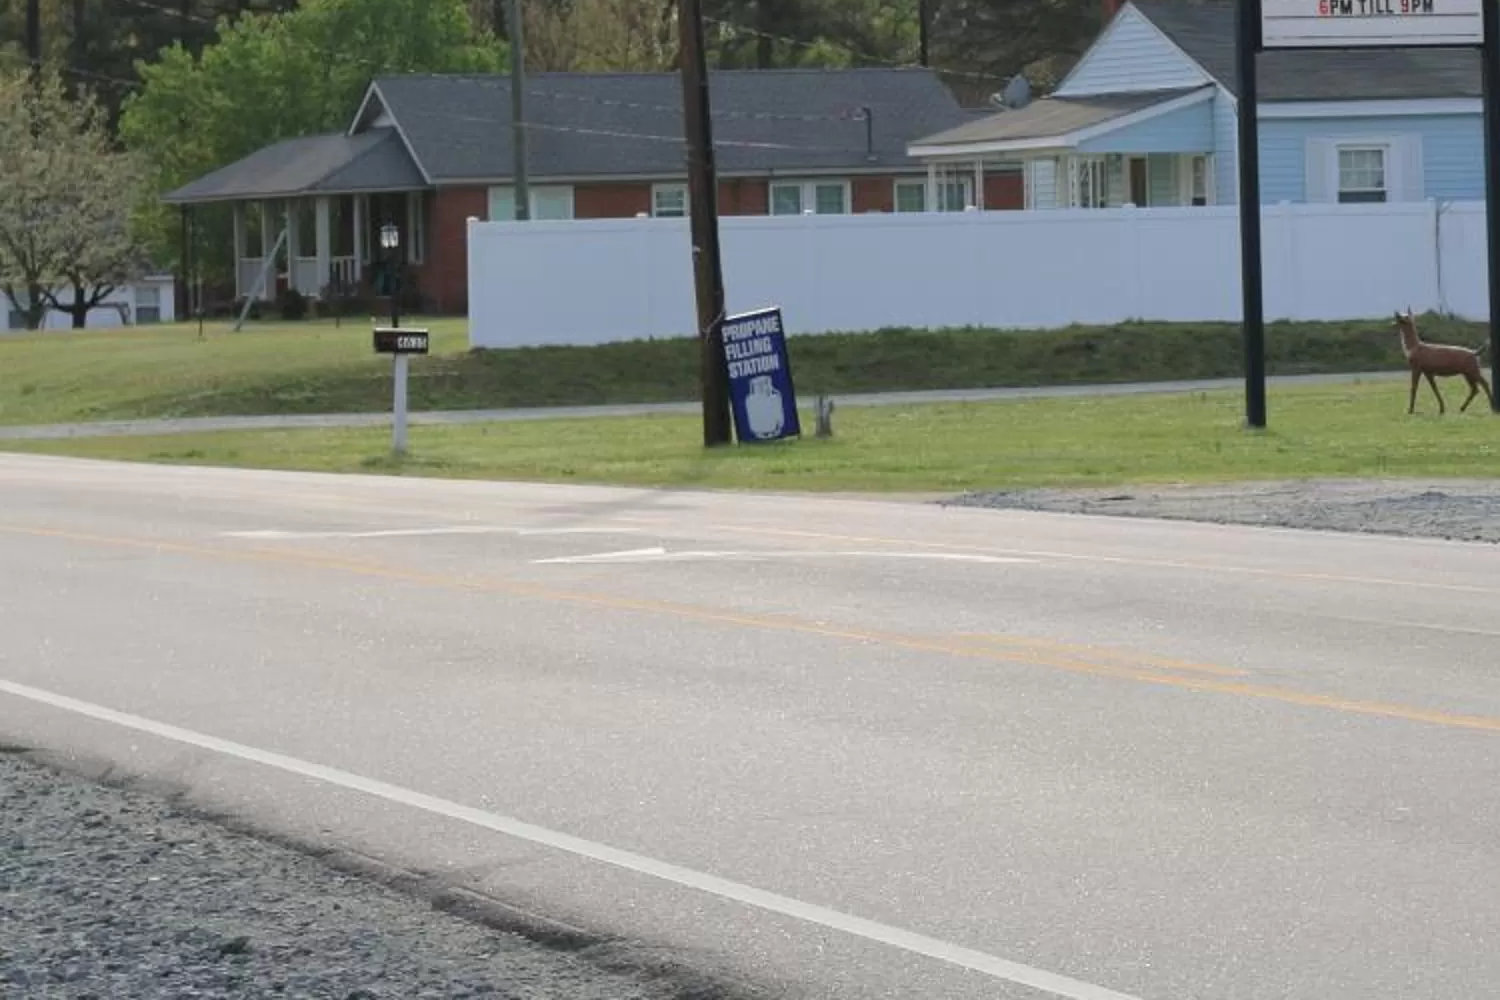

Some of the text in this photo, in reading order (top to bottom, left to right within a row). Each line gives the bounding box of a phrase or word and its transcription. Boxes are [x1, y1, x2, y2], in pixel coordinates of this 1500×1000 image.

[722, 316, 780, 342] PROPANE
[725, 337, 772, 360] FILLING
[728, 355, 779, 378] STATION
